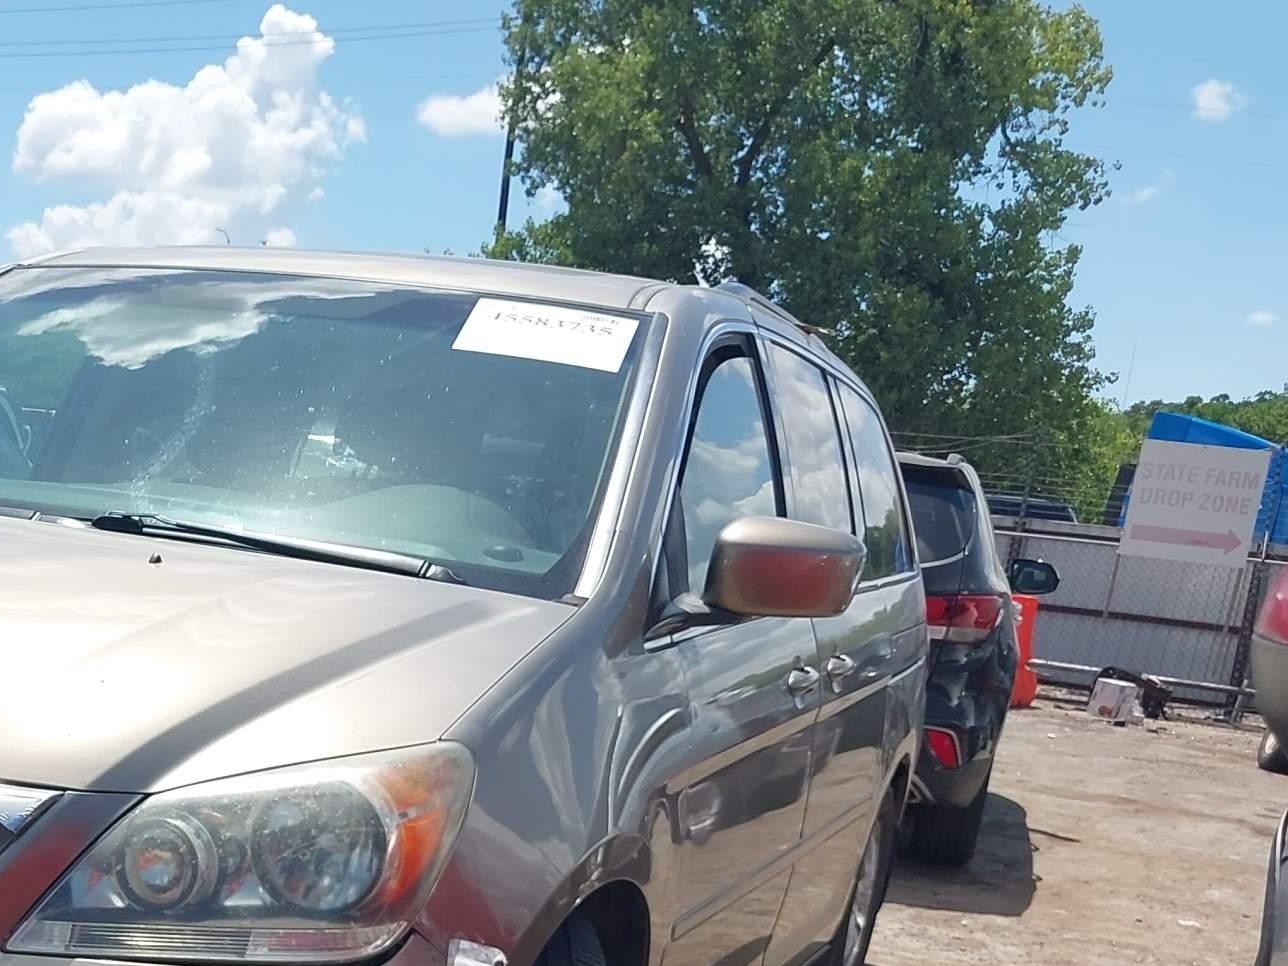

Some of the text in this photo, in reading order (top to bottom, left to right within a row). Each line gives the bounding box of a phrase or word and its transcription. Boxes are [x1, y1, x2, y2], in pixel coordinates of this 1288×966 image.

[1143, 463, 1260, 490] STATE FARM
[1141, 488, 1251, 515] DROP ZONE
